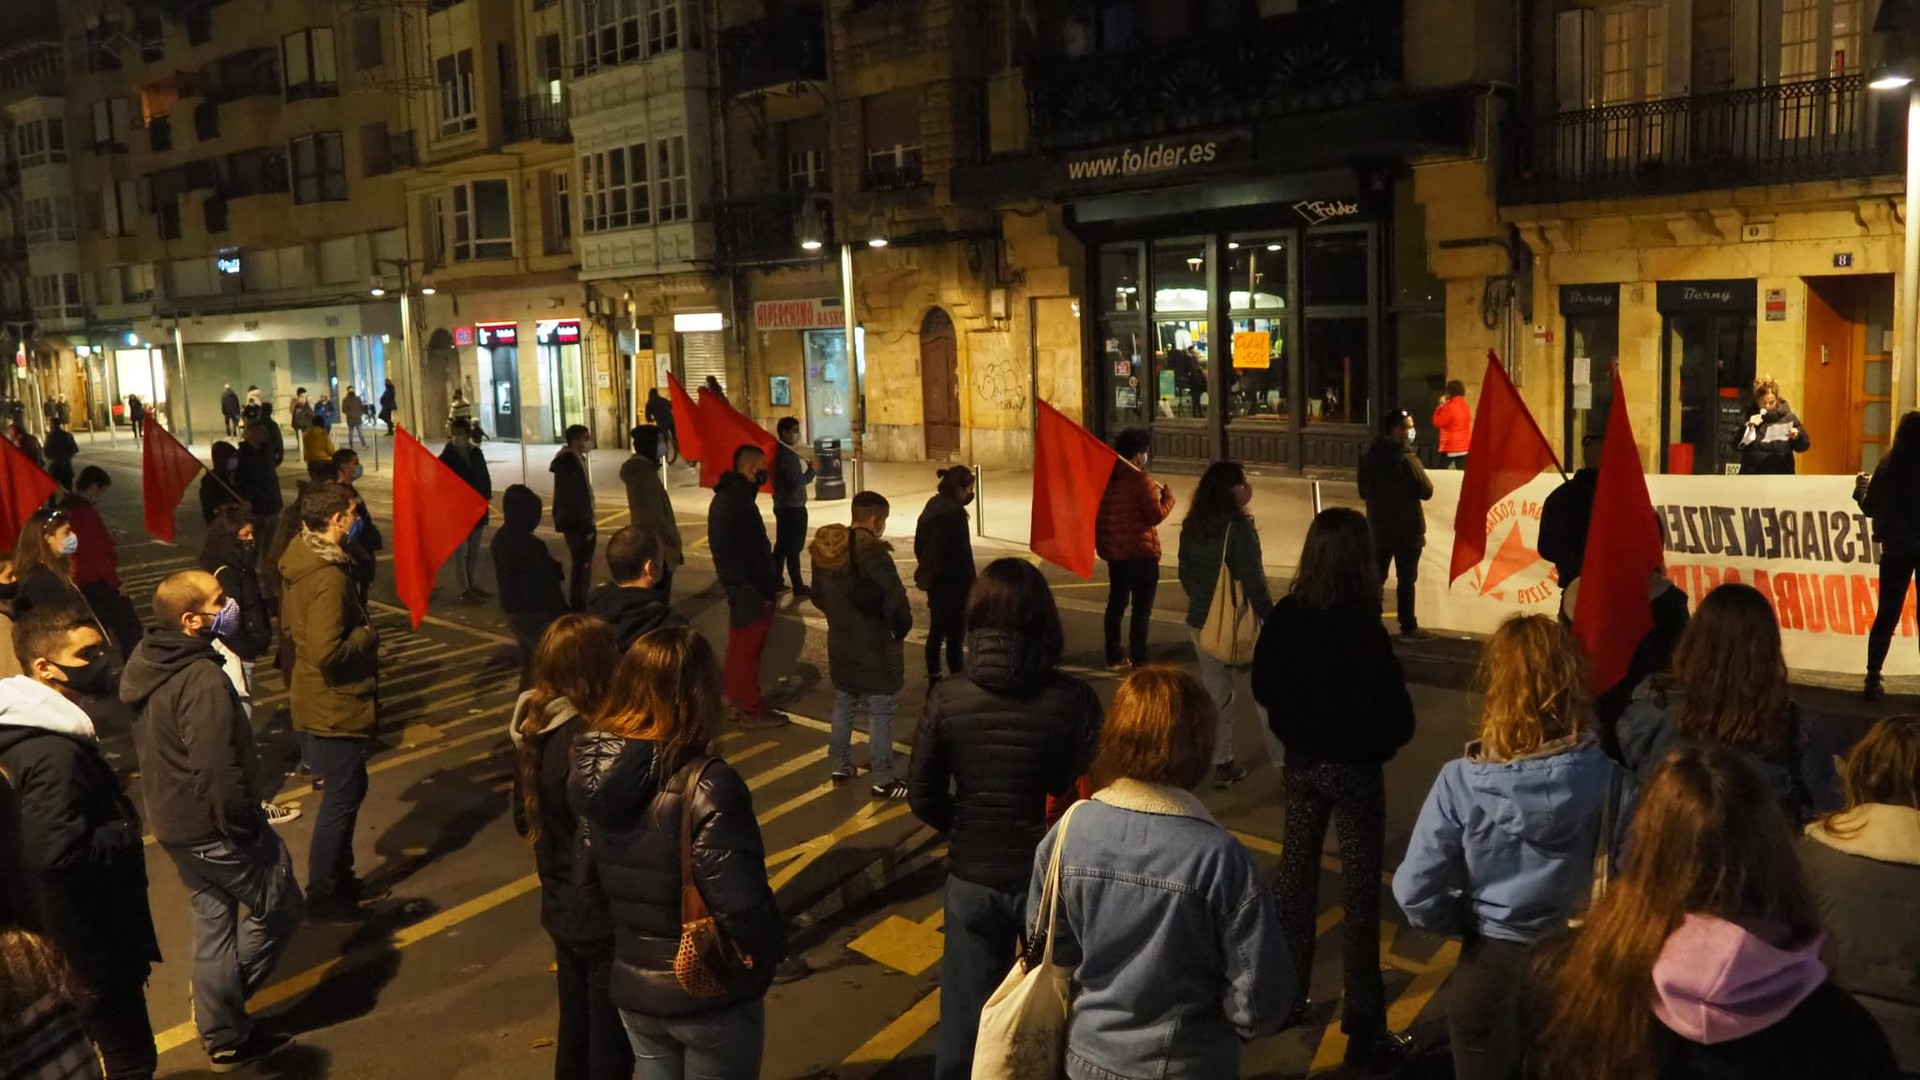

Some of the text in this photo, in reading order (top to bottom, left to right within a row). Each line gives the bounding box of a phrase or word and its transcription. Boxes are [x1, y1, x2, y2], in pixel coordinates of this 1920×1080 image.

[1068, 142, 1217, 180] www.folder.es
[1838, 254, 1847, 266] 8
[1569, 291, 1611, 305] Berny
[1683, 287, 1731, 302] Berny
